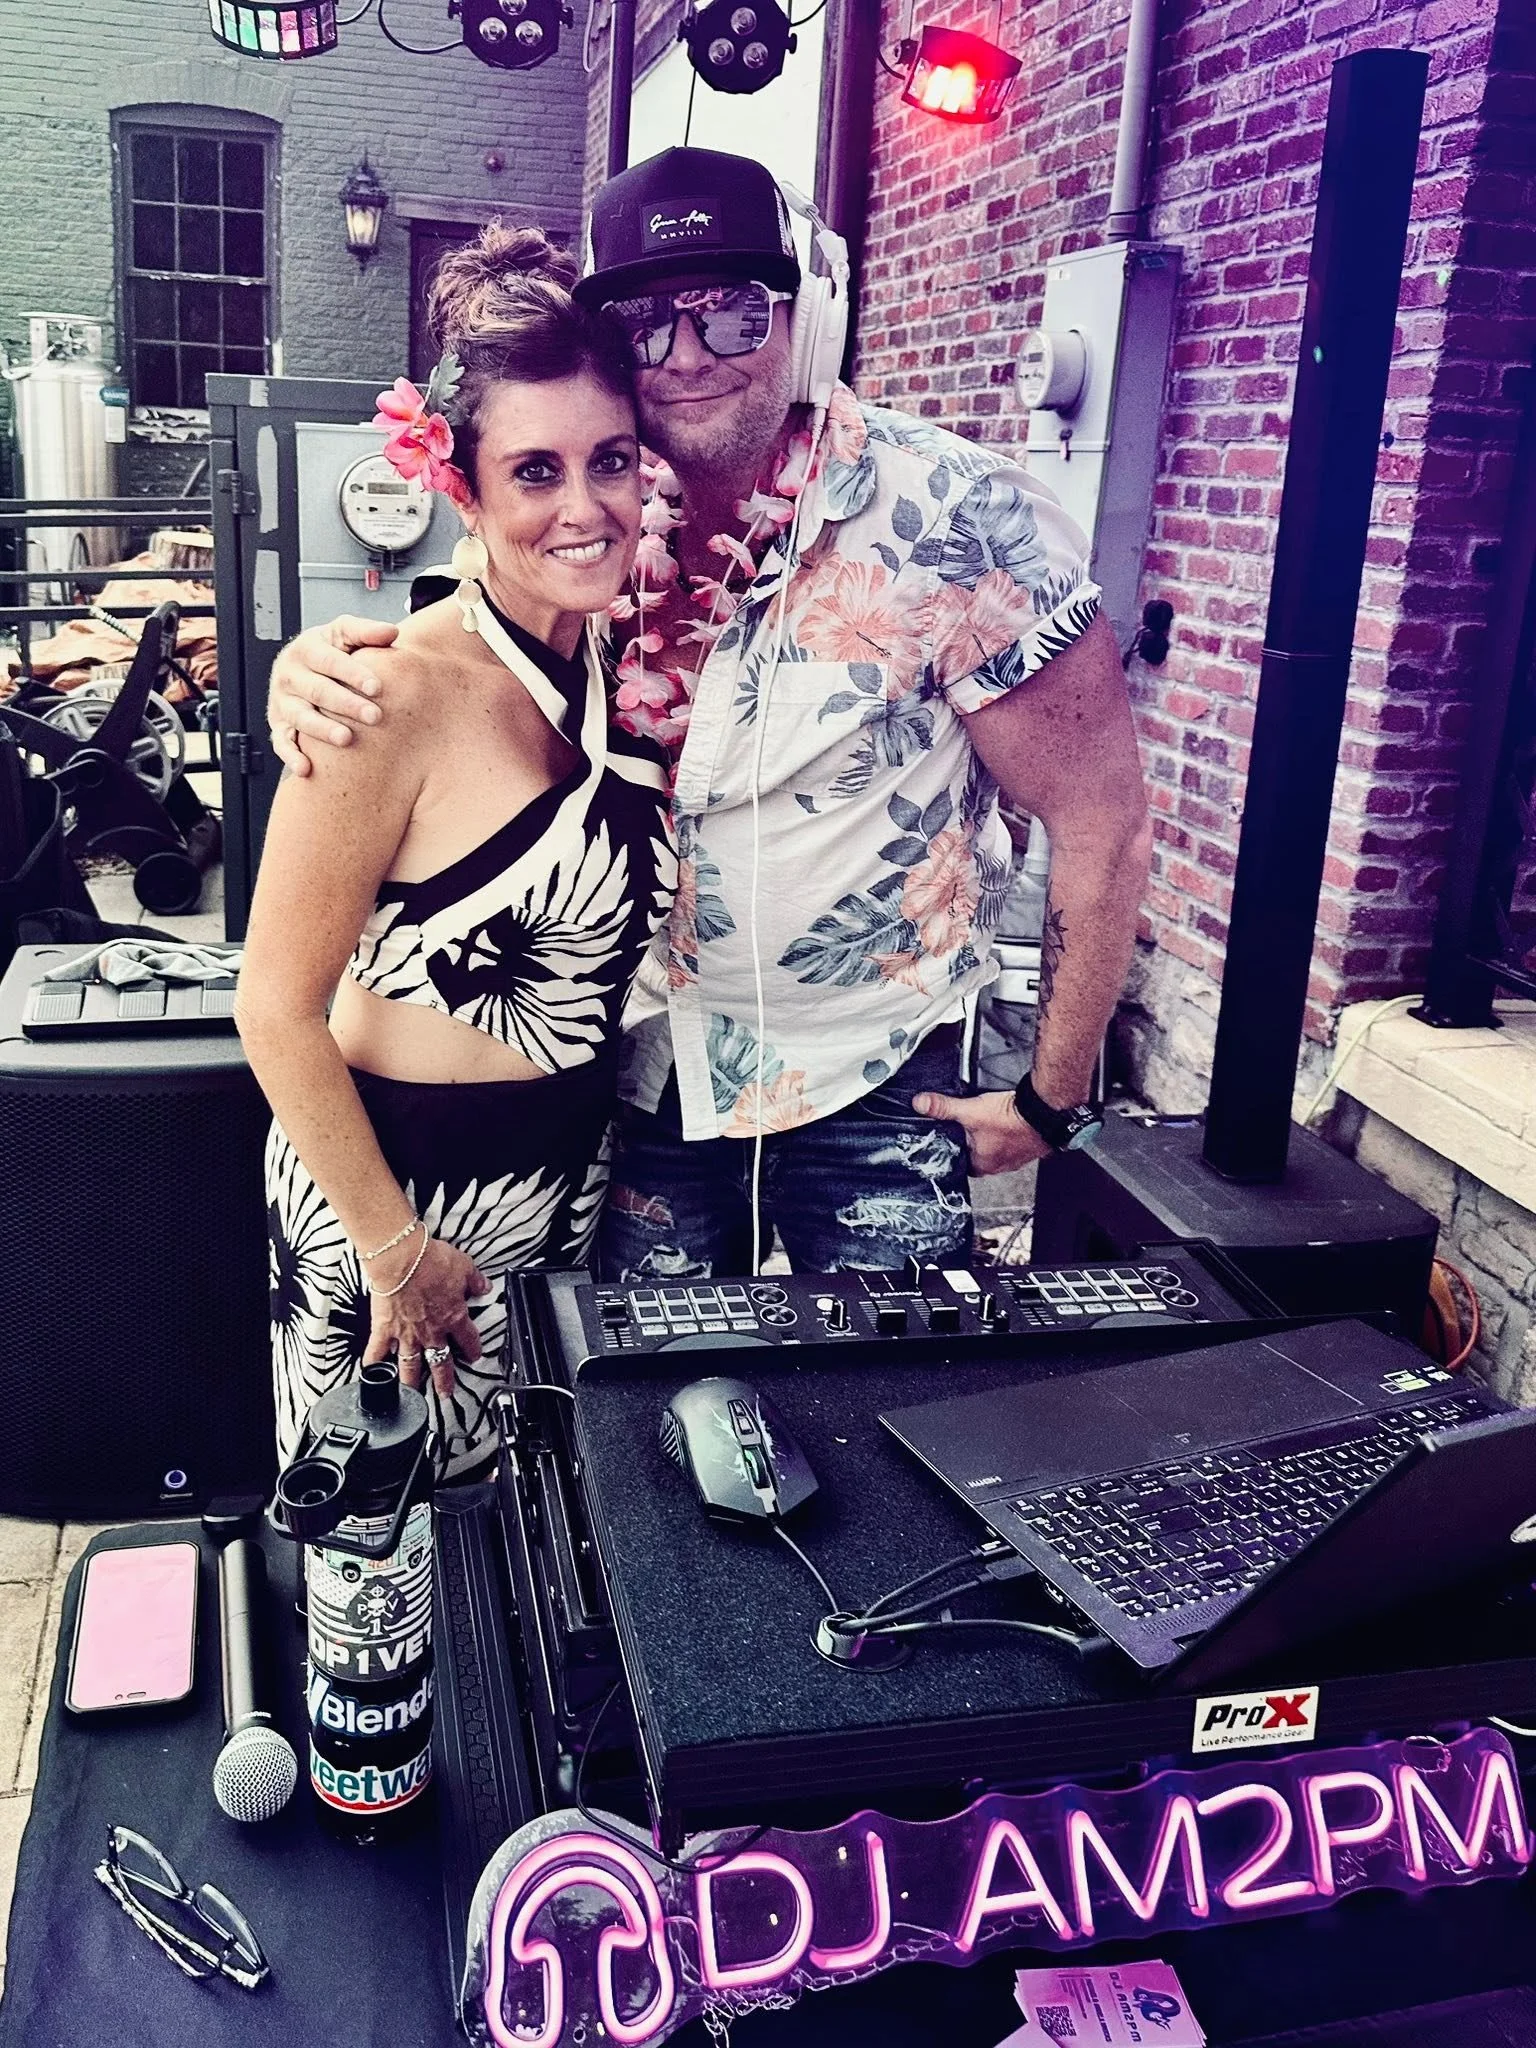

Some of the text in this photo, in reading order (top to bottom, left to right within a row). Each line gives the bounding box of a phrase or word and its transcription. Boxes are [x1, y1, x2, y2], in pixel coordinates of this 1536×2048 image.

[1201, 1692, 1311, 1732] ProX
[695, 1750, 1532, 1989] DJ AM2PM
